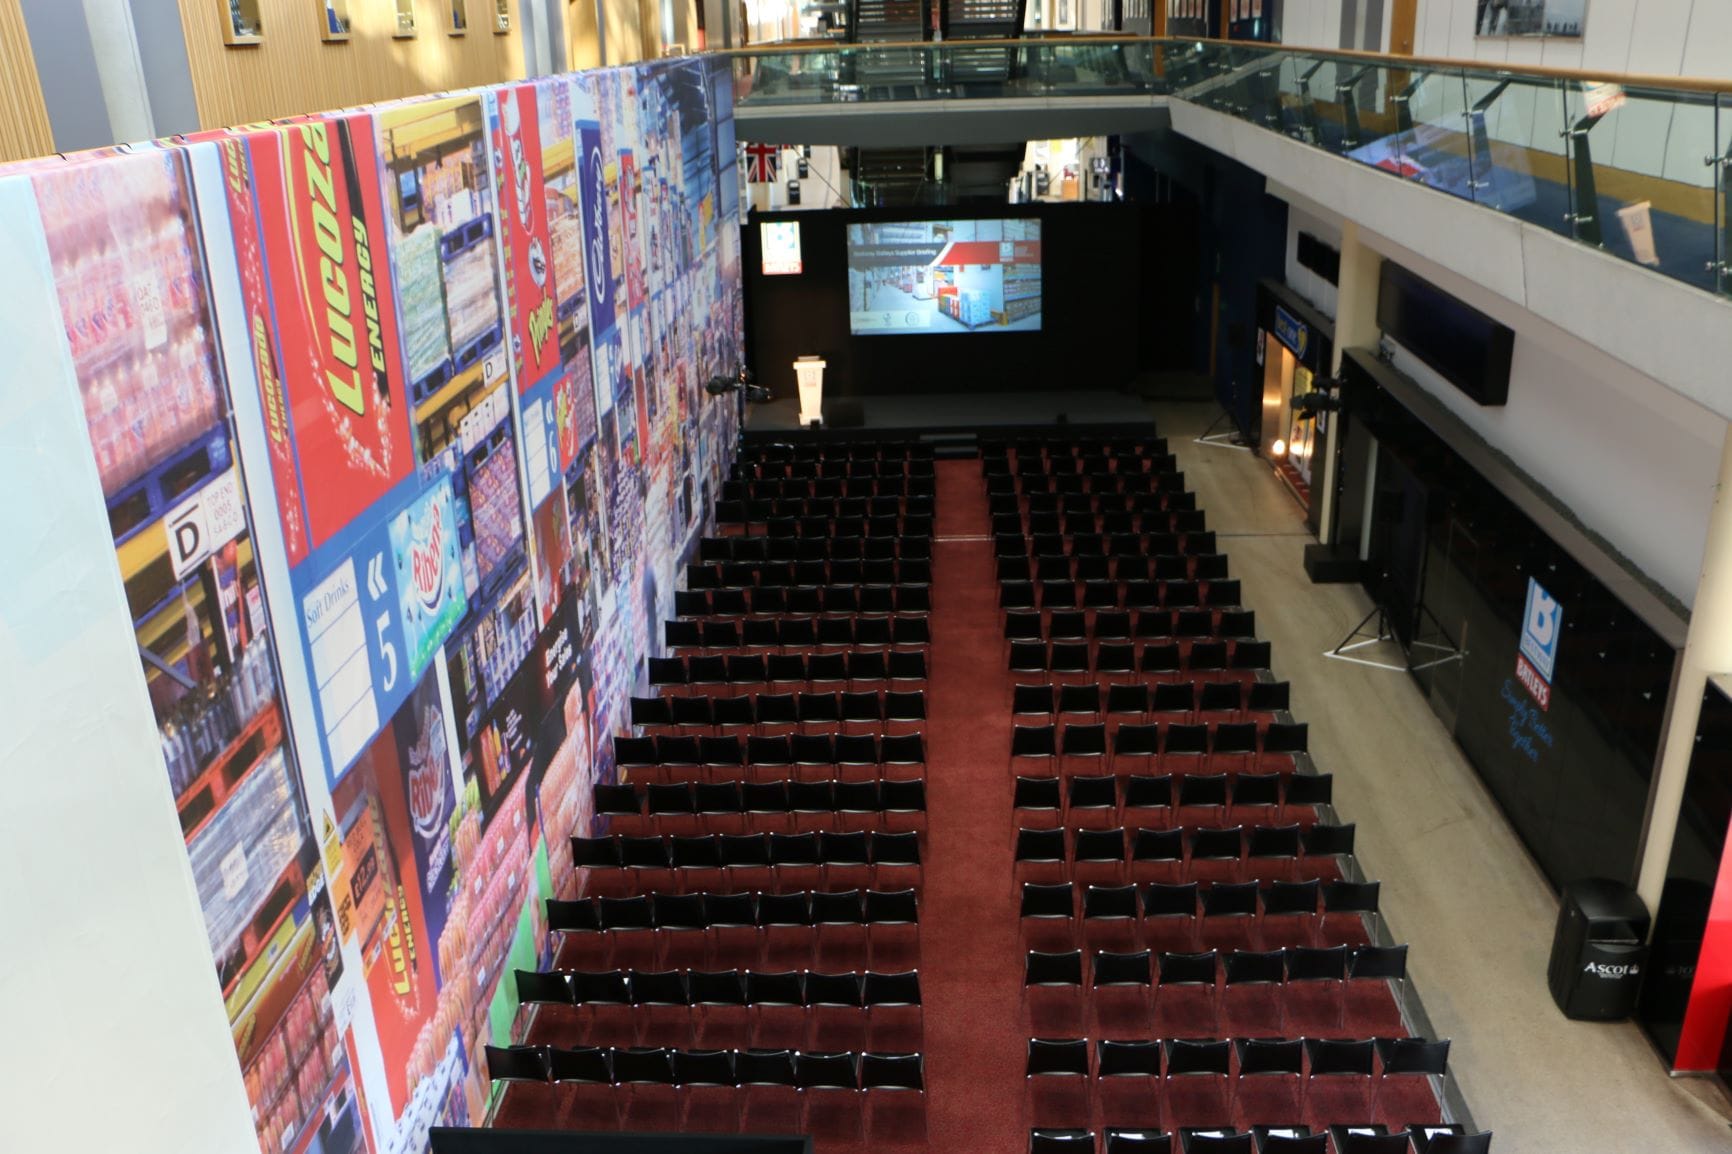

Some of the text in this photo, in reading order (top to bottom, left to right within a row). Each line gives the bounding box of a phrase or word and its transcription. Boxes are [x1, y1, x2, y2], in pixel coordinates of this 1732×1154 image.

[353, 216, 387, 374] ENERGY
[485, 361, 493, 380] D
[549, 430, 558, 474] 6
[175, 521, 200, 563] D
[413, 502, 442, 594] Ribena
[306, 575, 350, 629] Soft Drinks
[376, 611, 398, 693] 5
[1517, 657, 1549, 708] BATLEYS
